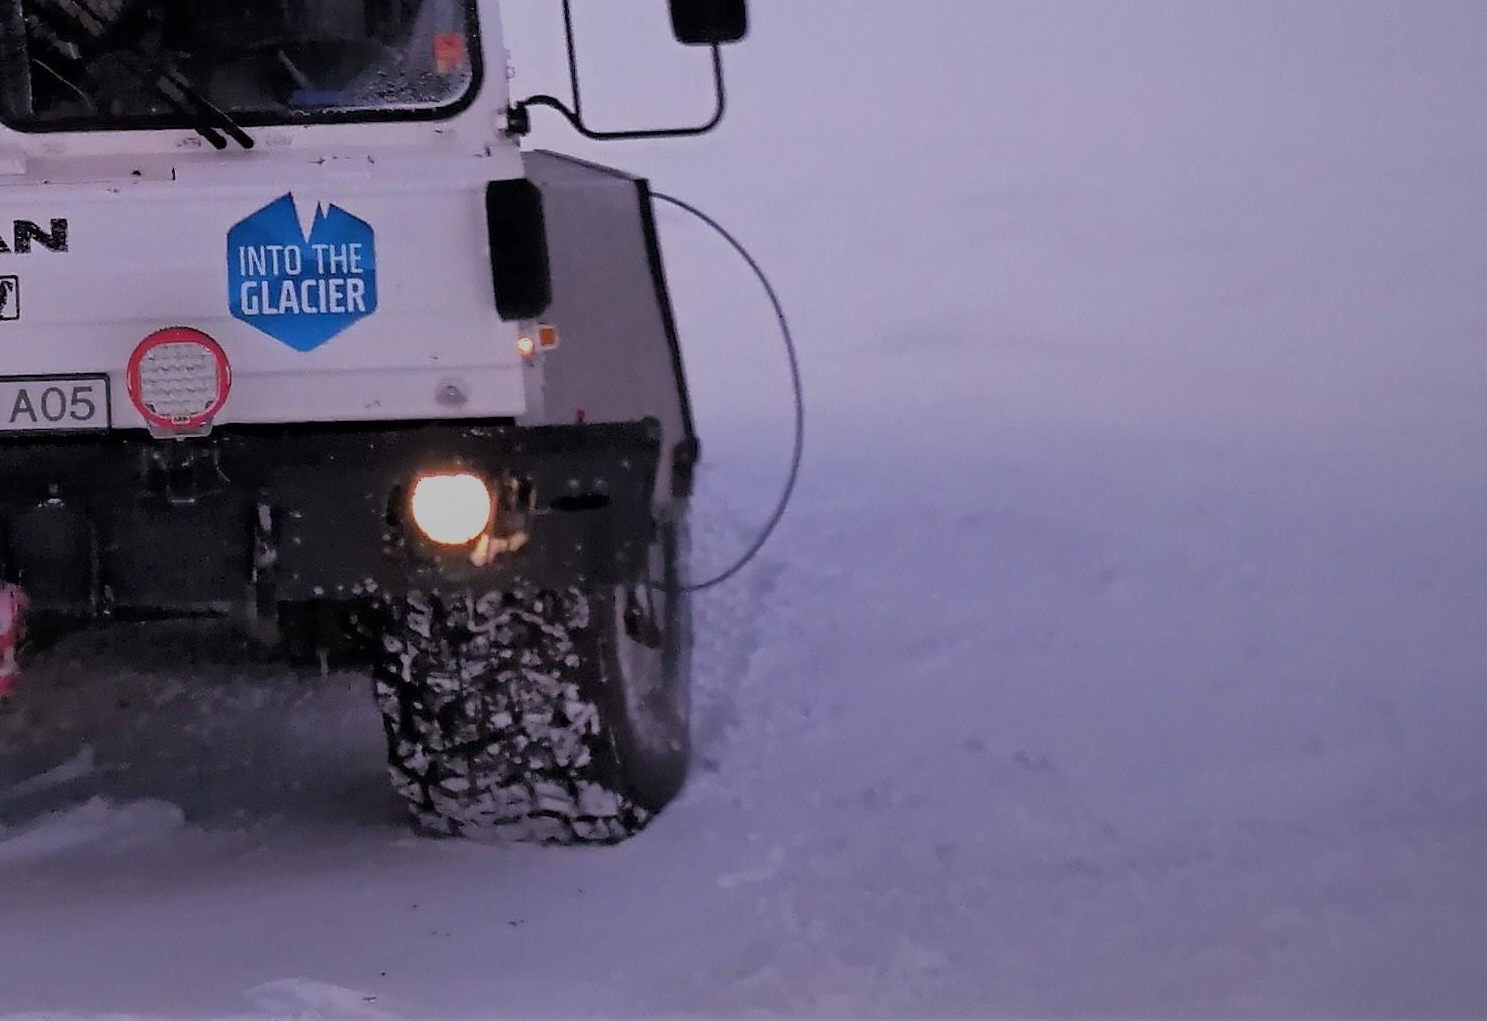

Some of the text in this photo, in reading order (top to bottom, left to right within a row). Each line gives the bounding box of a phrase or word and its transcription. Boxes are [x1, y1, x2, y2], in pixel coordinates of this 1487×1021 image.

[239, 243, 363, 276] INTO THE
[240, 278, 366, 315] GLACIER
[9, 386, 95, 423] A05
